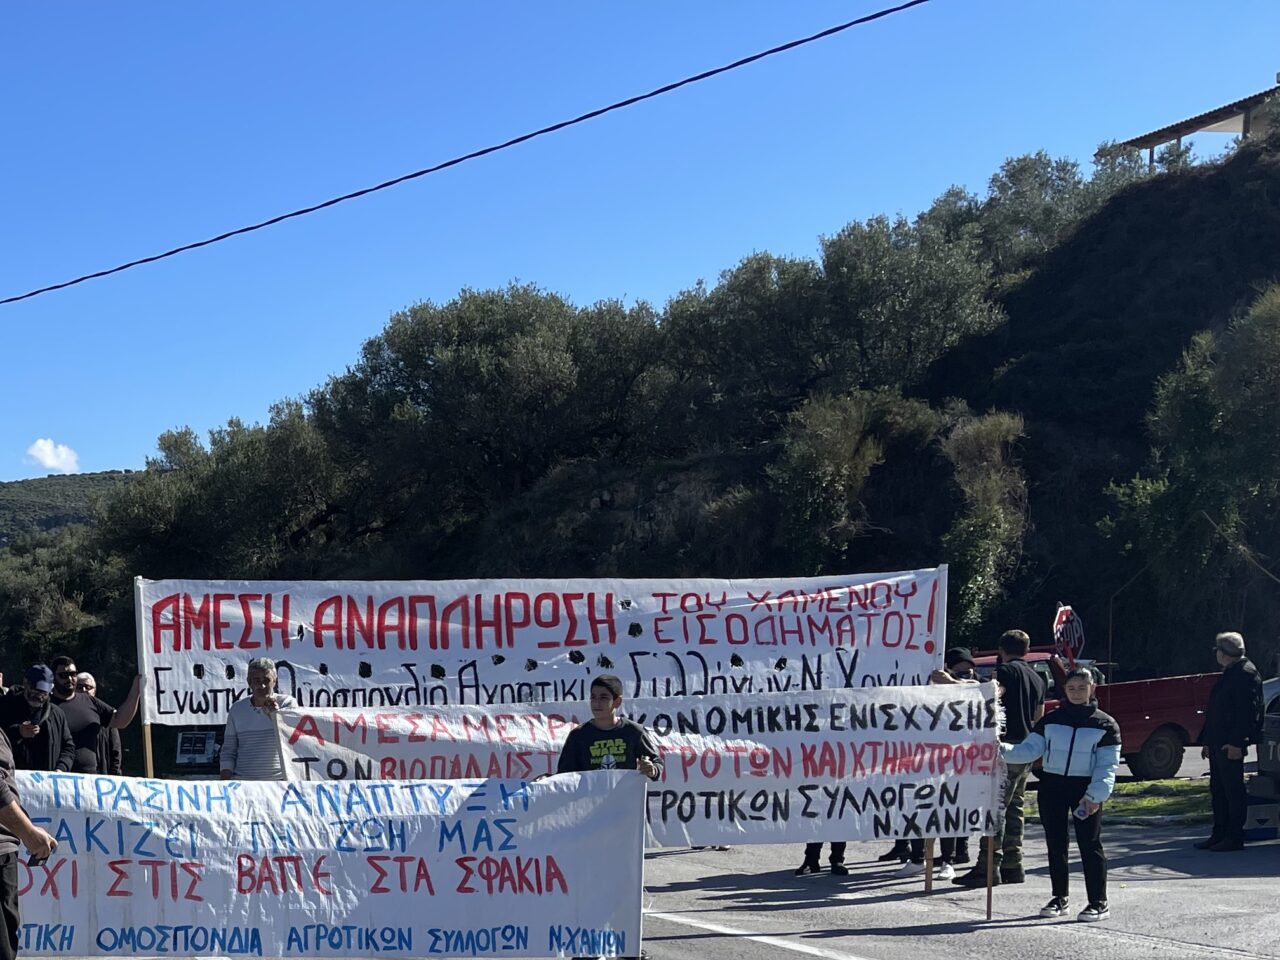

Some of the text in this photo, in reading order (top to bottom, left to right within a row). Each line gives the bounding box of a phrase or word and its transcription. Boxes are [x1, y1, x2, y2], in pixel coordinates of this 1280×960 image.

[652, 581, 918, 615] ΤΟΥ ΧΑΜΕΝΟΥ
[152, 591, 617, 654] ΑΜΕΣΗ ΑΝΑΠΛΗΡΩΣΗ
[289, 712, 456, 746] ΑΜΕΣΑ
[830, 698, 999, 732] ΕΝΙΣΧΥΣΗΣ
[380, 751, 561, 780] ΒΙΟΠΑΛΑΙΣΤ
[658, 745, 793, 783] ΓΡΟΤΩΝ
[801, 741, 847, 779] ΚΑΙ
[590, 738, 626, 749] STAR
[590, 746, 626, 757] WARS
[281, 782, 530, 817] ΑΝΑΠΤΥΞΗ
[646, 782, 959, 824] ΓΡΟΤΙΚΩΝ ΣΥΛΛΟΓΩΝ
[329, 817, 406, 853] ΖΩΗ
[438, 818, 518, 854] ΜΑΣ
[106, 859, 205, 902] ΣΤΙΣ
[366, 855, 436, 896] ΣΤΑ
[454, 855, 569, 897] ΣΦΑΚΙΑ
[17, 923, 75, 952] ΤΙΚΗ
[96, 925, 263, 956] ΟΜΟΣΠΟΝΔΙΑ
[287, 924, 413, 952] ΑΓΡΟΤΙΚΩΝ
[428, 924, 529, 956] ΣΥΛΛΟΓΩΝ
